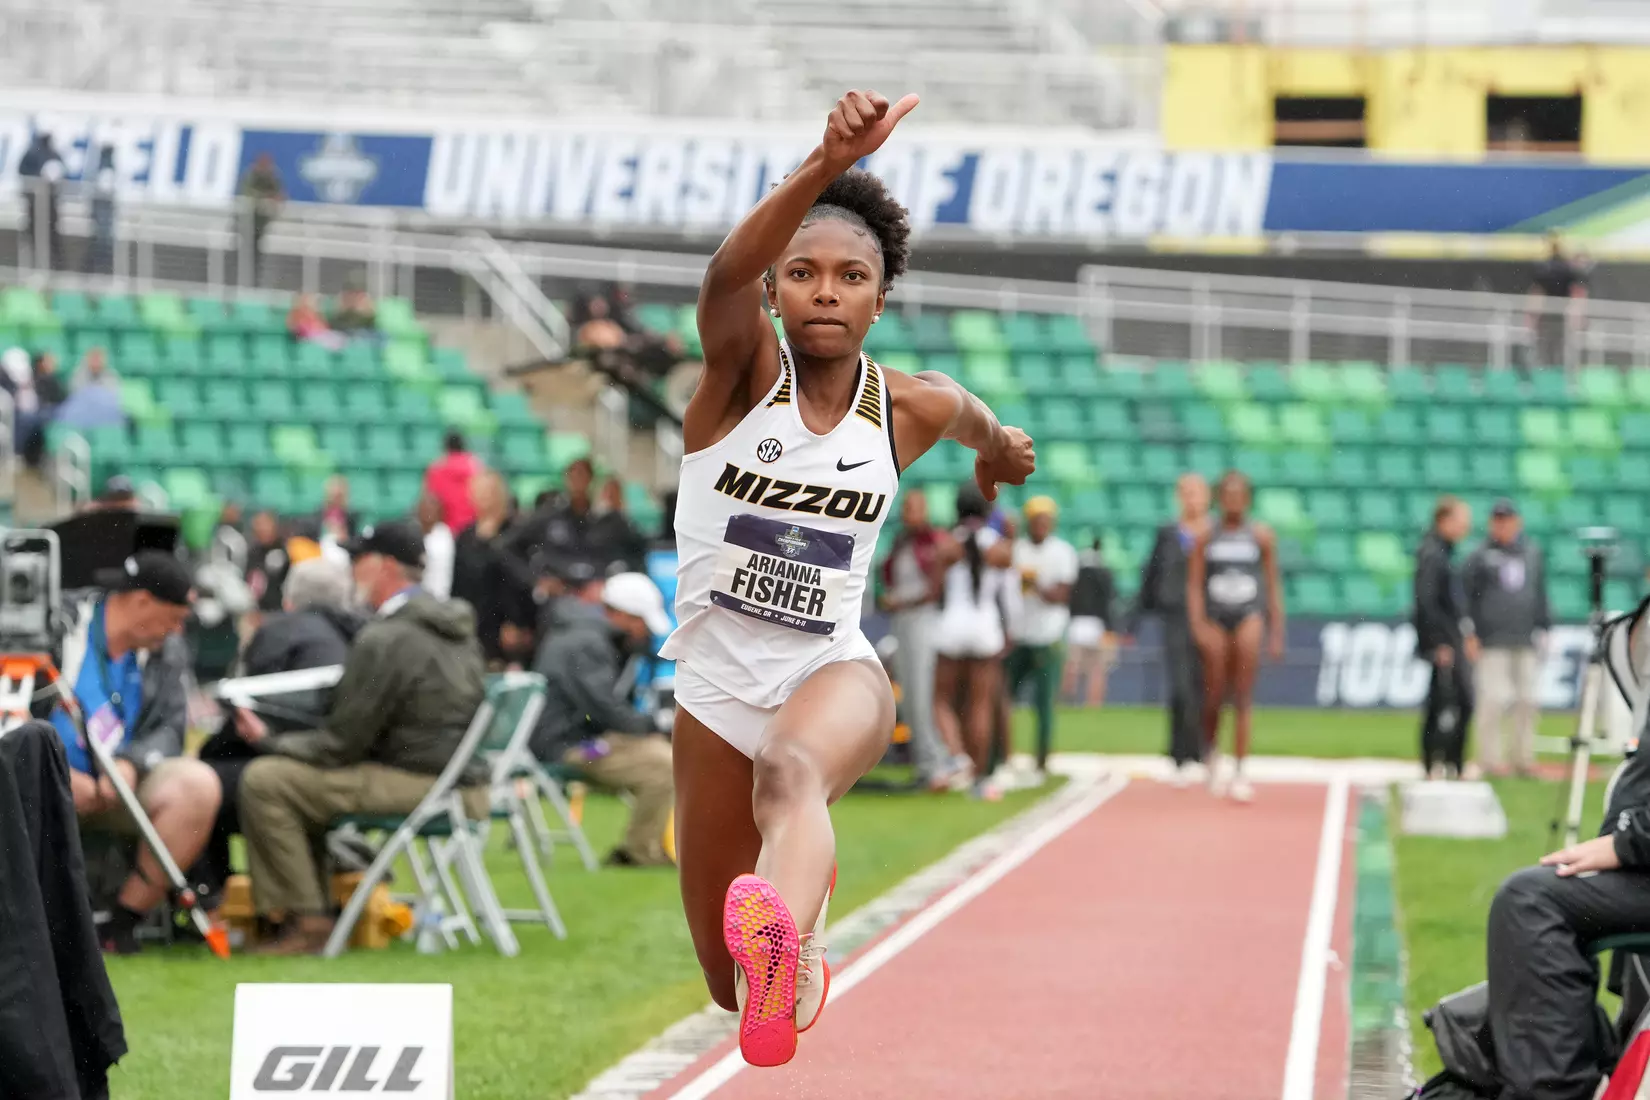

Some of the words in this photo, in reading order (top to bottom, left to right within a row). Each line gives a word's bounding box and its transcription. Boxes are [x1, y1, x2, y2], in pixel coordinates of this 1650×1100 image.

[969, 148, 1272, 235] OREGON
[758, 439, 782, 462] SEC
[713, 462, 886, 522] MIZZOU
[730, 567, 827, 617] FISHER
[746, 554, 821, 586] ARIANNA
[763, 610, 772, 618] OR
[780, 615, 796, 625] JUNE
[253, 1046, 424, 1091] GILL
